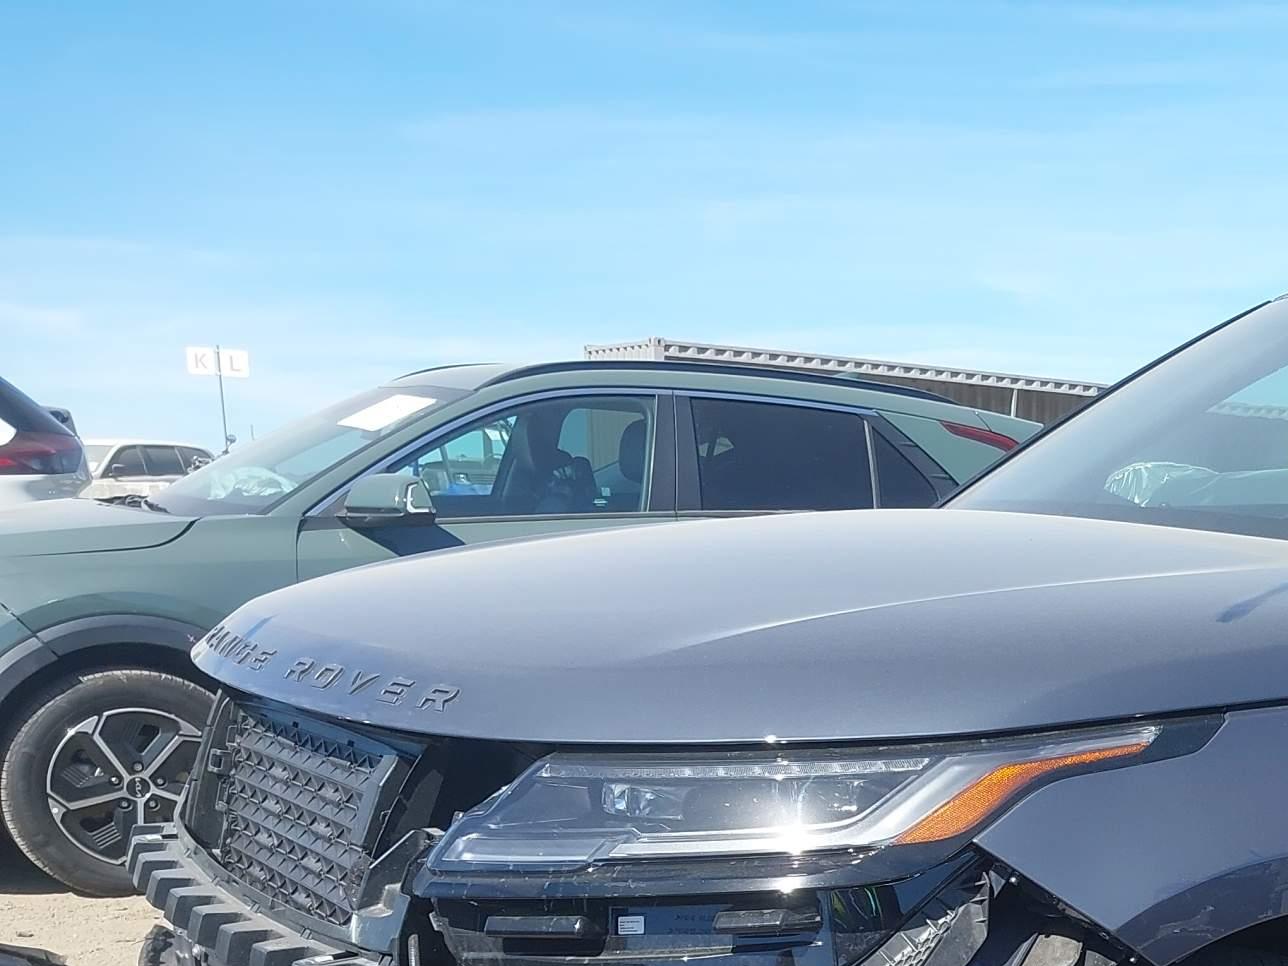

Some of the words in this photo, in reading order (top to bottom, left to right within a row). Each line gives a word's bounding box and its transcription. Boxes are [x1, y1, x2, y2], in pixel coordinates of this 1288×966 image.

[194, 352, 208, 369] K
[229, 354, 242, 372] L
[283, 656, 462, 712] ROVER
